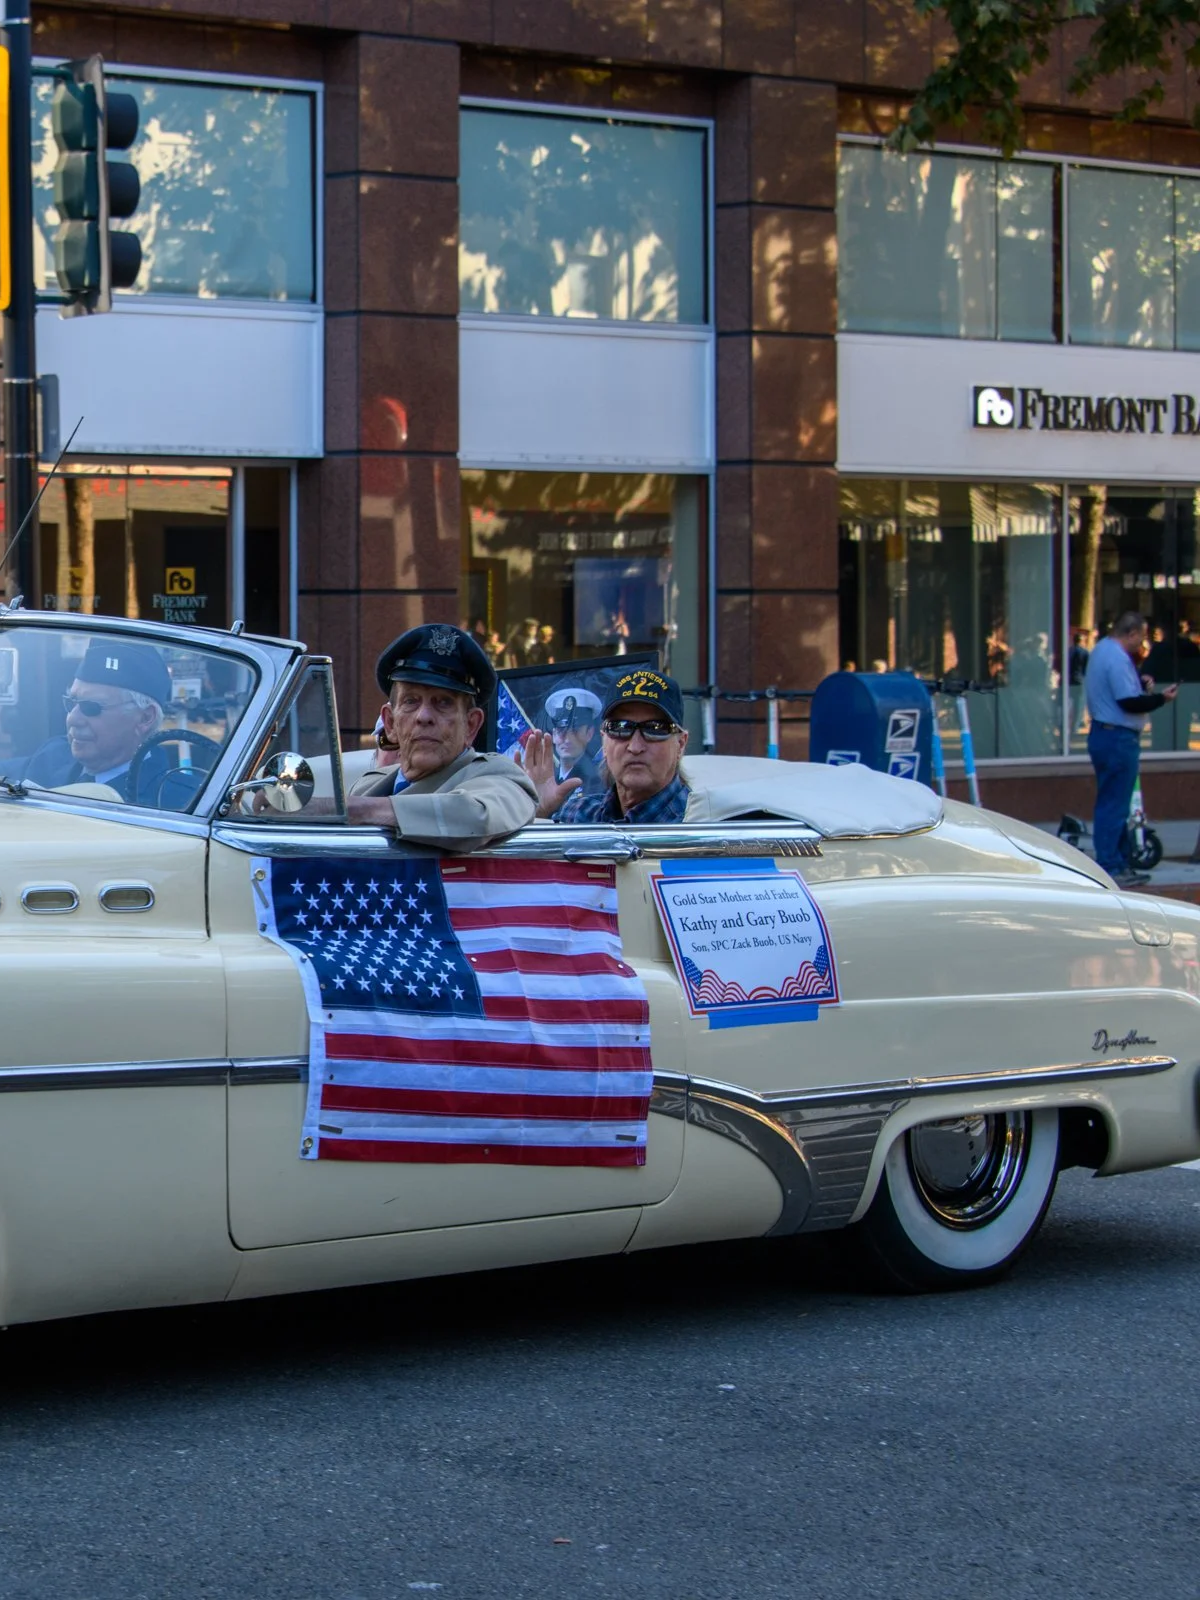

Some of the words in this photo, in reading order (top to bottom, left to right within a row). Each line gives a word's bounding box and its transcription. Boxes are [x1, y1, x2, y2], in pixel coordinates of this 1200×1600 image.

[1017, 388, 1168, 433] FREMONT
[153, 594, 208, 609] FREMONT
[164, 608, 197, 623] BANK
[616, 675, 632, 688] USS
[632, 671, 668, 690] ANTIETAM
[672, 893, 698, 907] Gold
[698, 893, 718, 905] Star
[718, 891, 752, 903] Mother
[754, 889, 771, 901] and
[771, 888, 800, 900] Father
[679, 914, 718, 934] Kathy
[721, 912, 744, 929] and
[746, 911, 776, 930] Gary
[778, 908, 811, 924] Buob
[691, 942, 710, 953] Son,
[711, 939, 731, 952] SPC
[732, 937, 751, 950] Zack
[752, 936, 777, 948] Buob,
[778, 934, 791, 946] US
[792, 933, 812, 946] Navy
